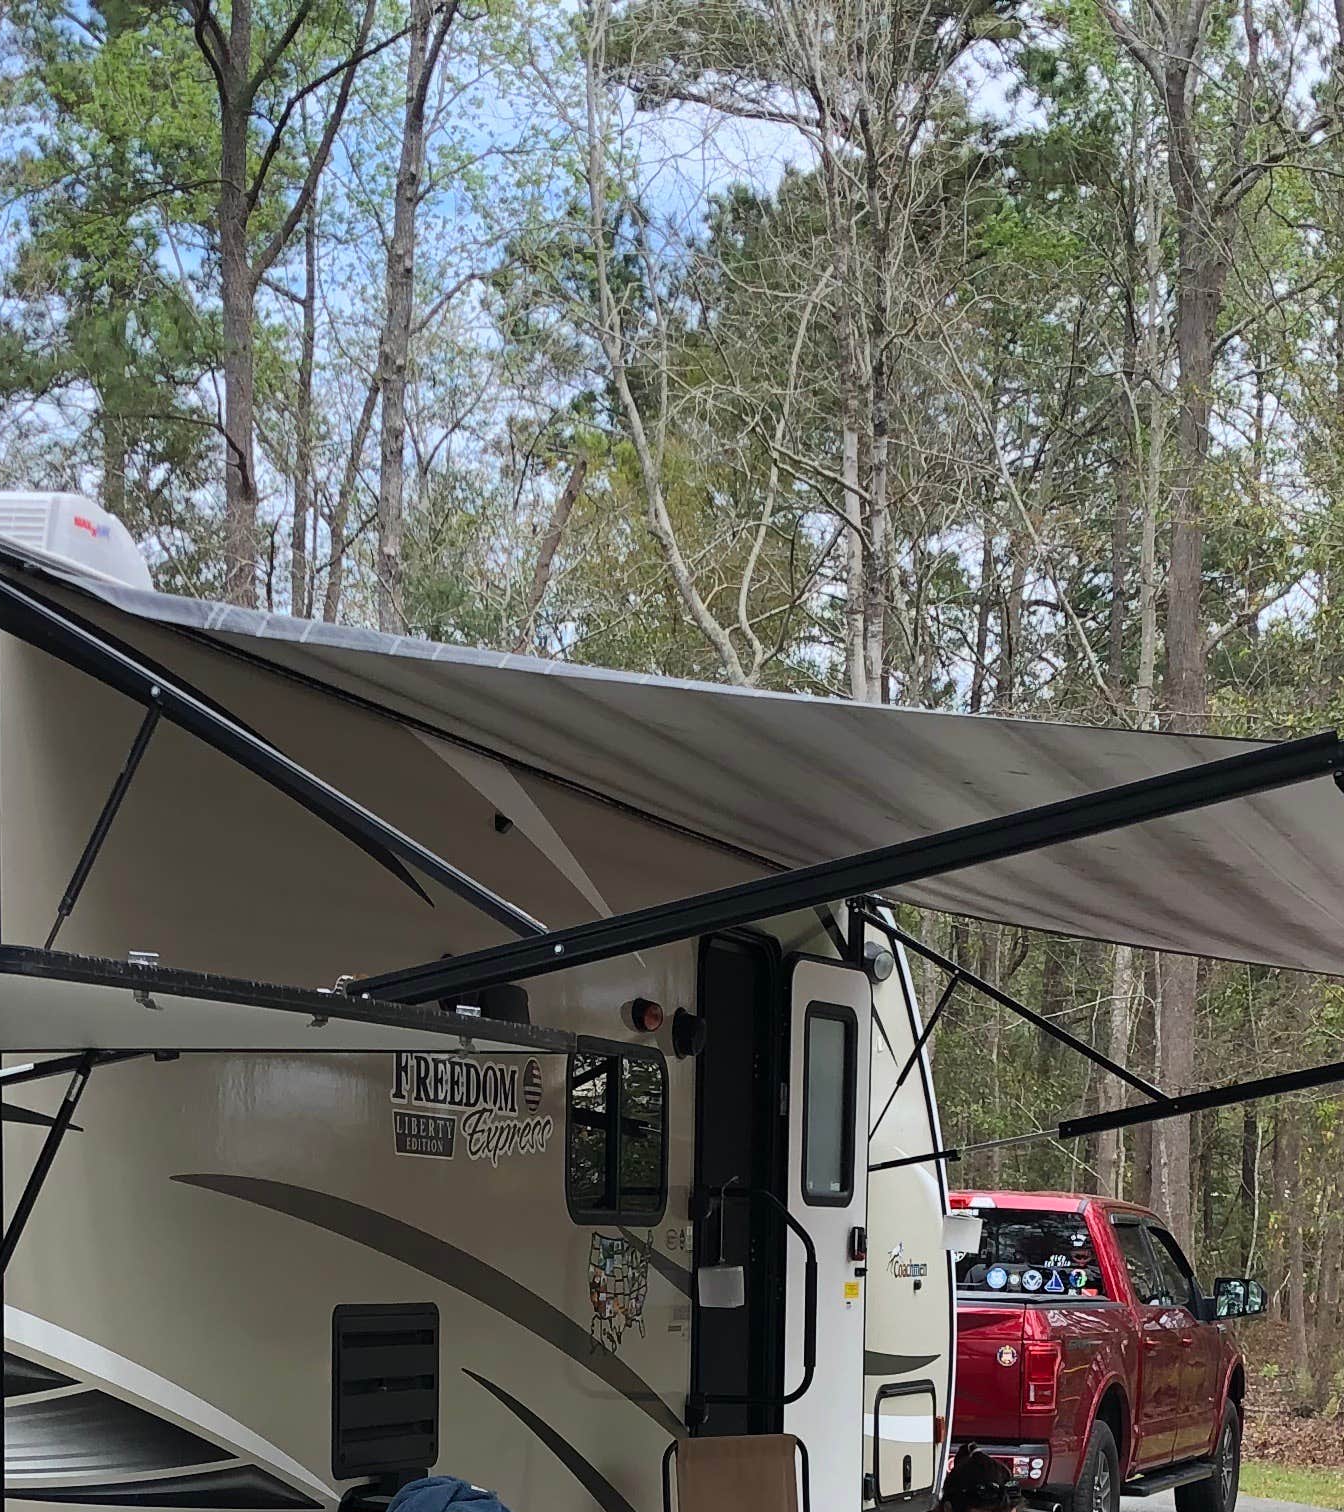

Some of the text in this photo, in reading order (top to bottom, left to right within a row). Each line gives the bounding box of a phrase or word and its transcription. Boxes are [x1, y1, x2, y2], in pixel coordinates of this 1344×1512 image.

[392, 1053, 517, 1113] FREEDOM
[396, 1115, 454, 1139] LIBERTY
[406, 1139, 444, 1153] EDITION
[462, 1108, 551, 1164] Express
